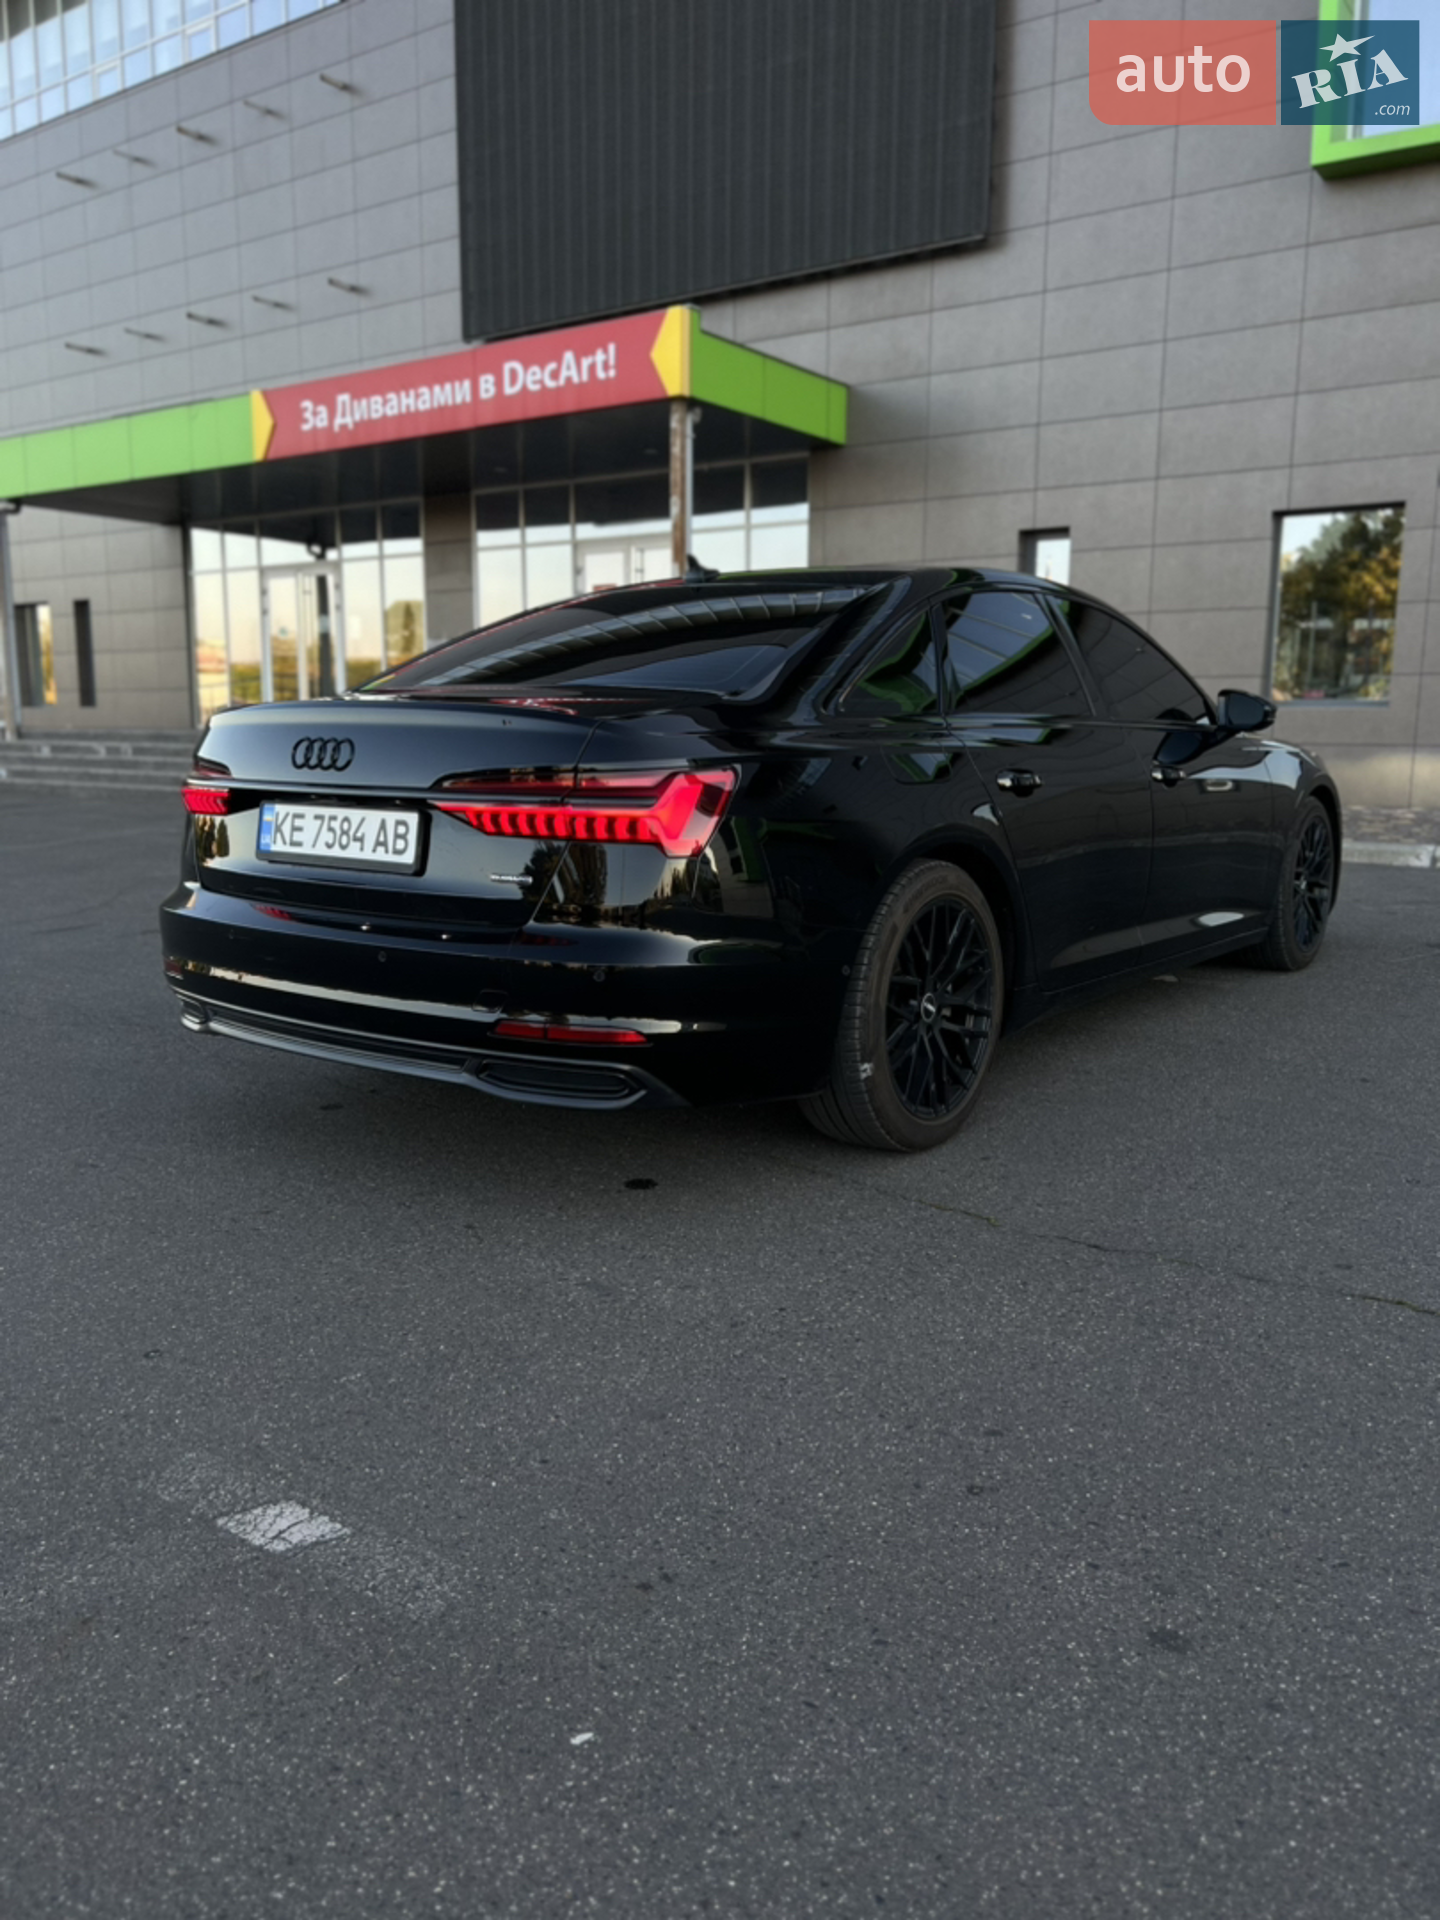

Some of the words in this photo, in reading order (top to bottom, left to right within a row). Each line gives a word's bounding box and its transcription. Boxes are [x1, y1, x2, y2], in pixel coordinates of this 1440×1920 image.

[300, 399, 328, 431] За
[333, 379, 471, 432] Диванами
[479, 372, 495, 399] в
[503, 342, 617, 395] DecArt!
[273, 811, 305, 847] KE
[311, 814, 366, 852] 7584
[371, 817, 410, 856] AB
